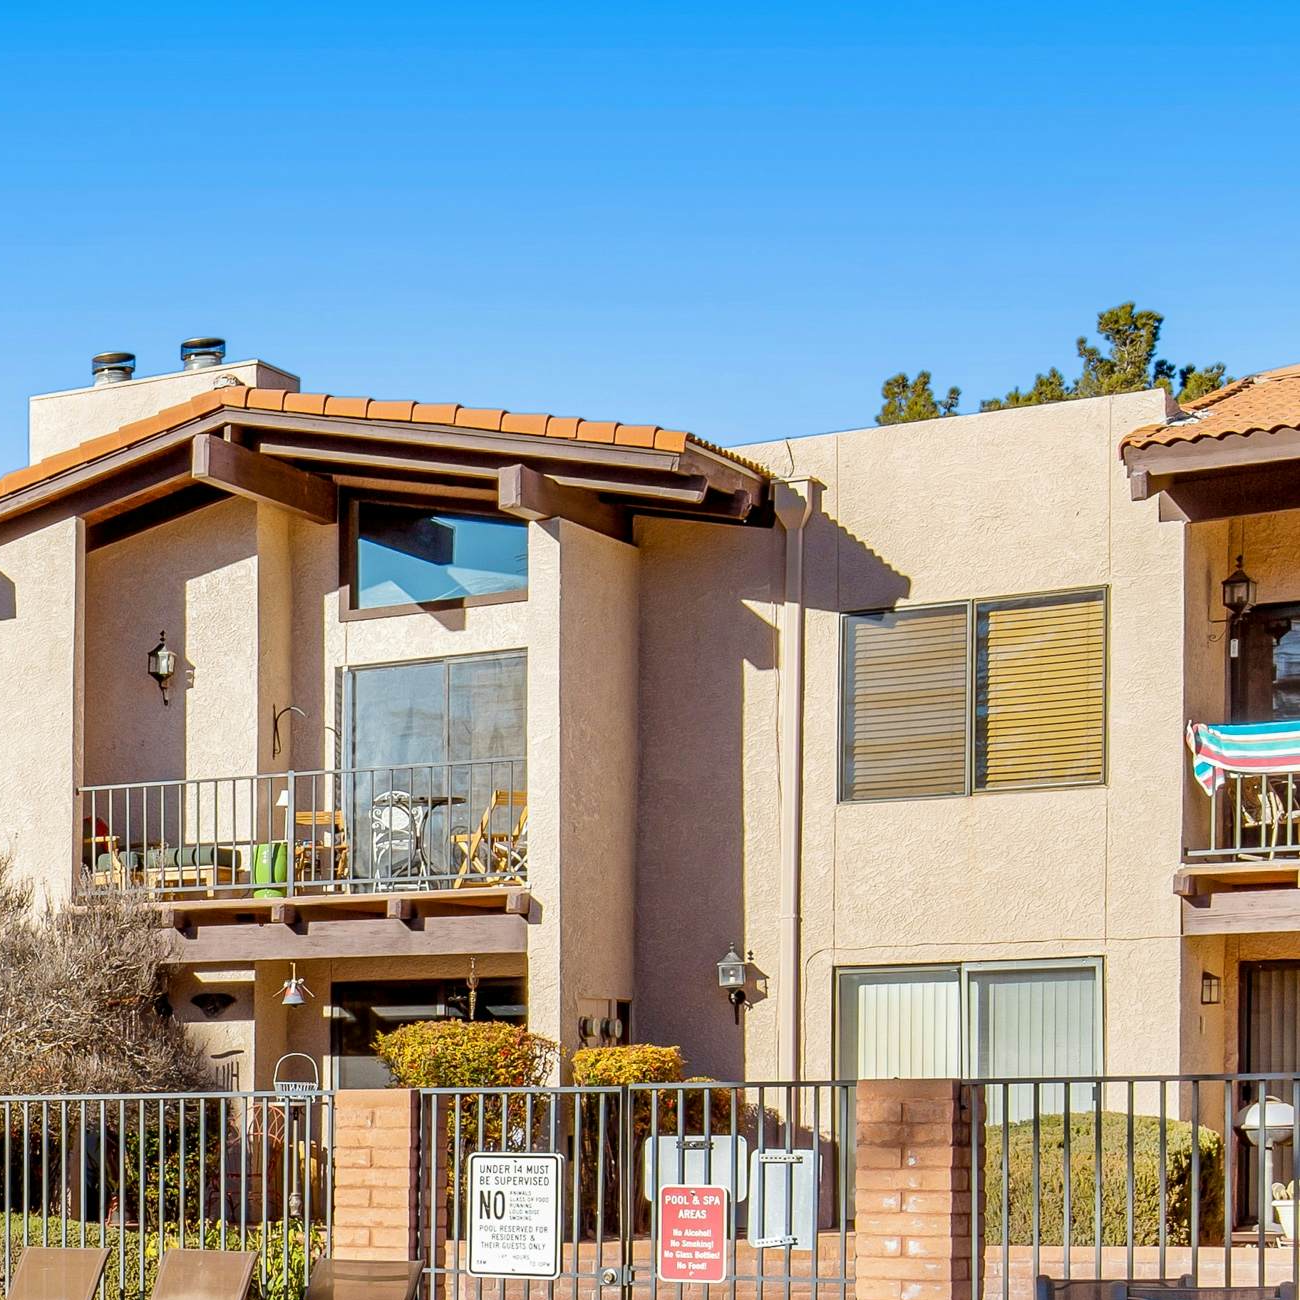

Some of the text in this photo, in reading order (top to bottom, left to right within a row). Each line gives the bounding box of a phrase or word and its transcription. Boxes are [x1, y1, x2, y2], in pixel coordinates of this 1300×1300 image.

[480, 1164, 549, 1174] UNDER 14 MUST
[480, 1176, 550, 1186] BE SUPERVISED
[479, 1190, 505, 1220] NO
[665, 1195, 720, 1206] POOL & SPA
[678, 1210, 707, 1219] AREAS
[480, 1224, 496, 1232] POOL
[500, 1225, 533, 1233] RESERVED
[491, 1233, 535, 1242] RESIDENTS &
[481, 1241, 546, 1250] THEIR GUESTS ONLY
[670, 1239, 714, 1249] No Smoking!
[663, 1250, 674, 1258] No
[677, 1261, 707, 1270] No Food!
